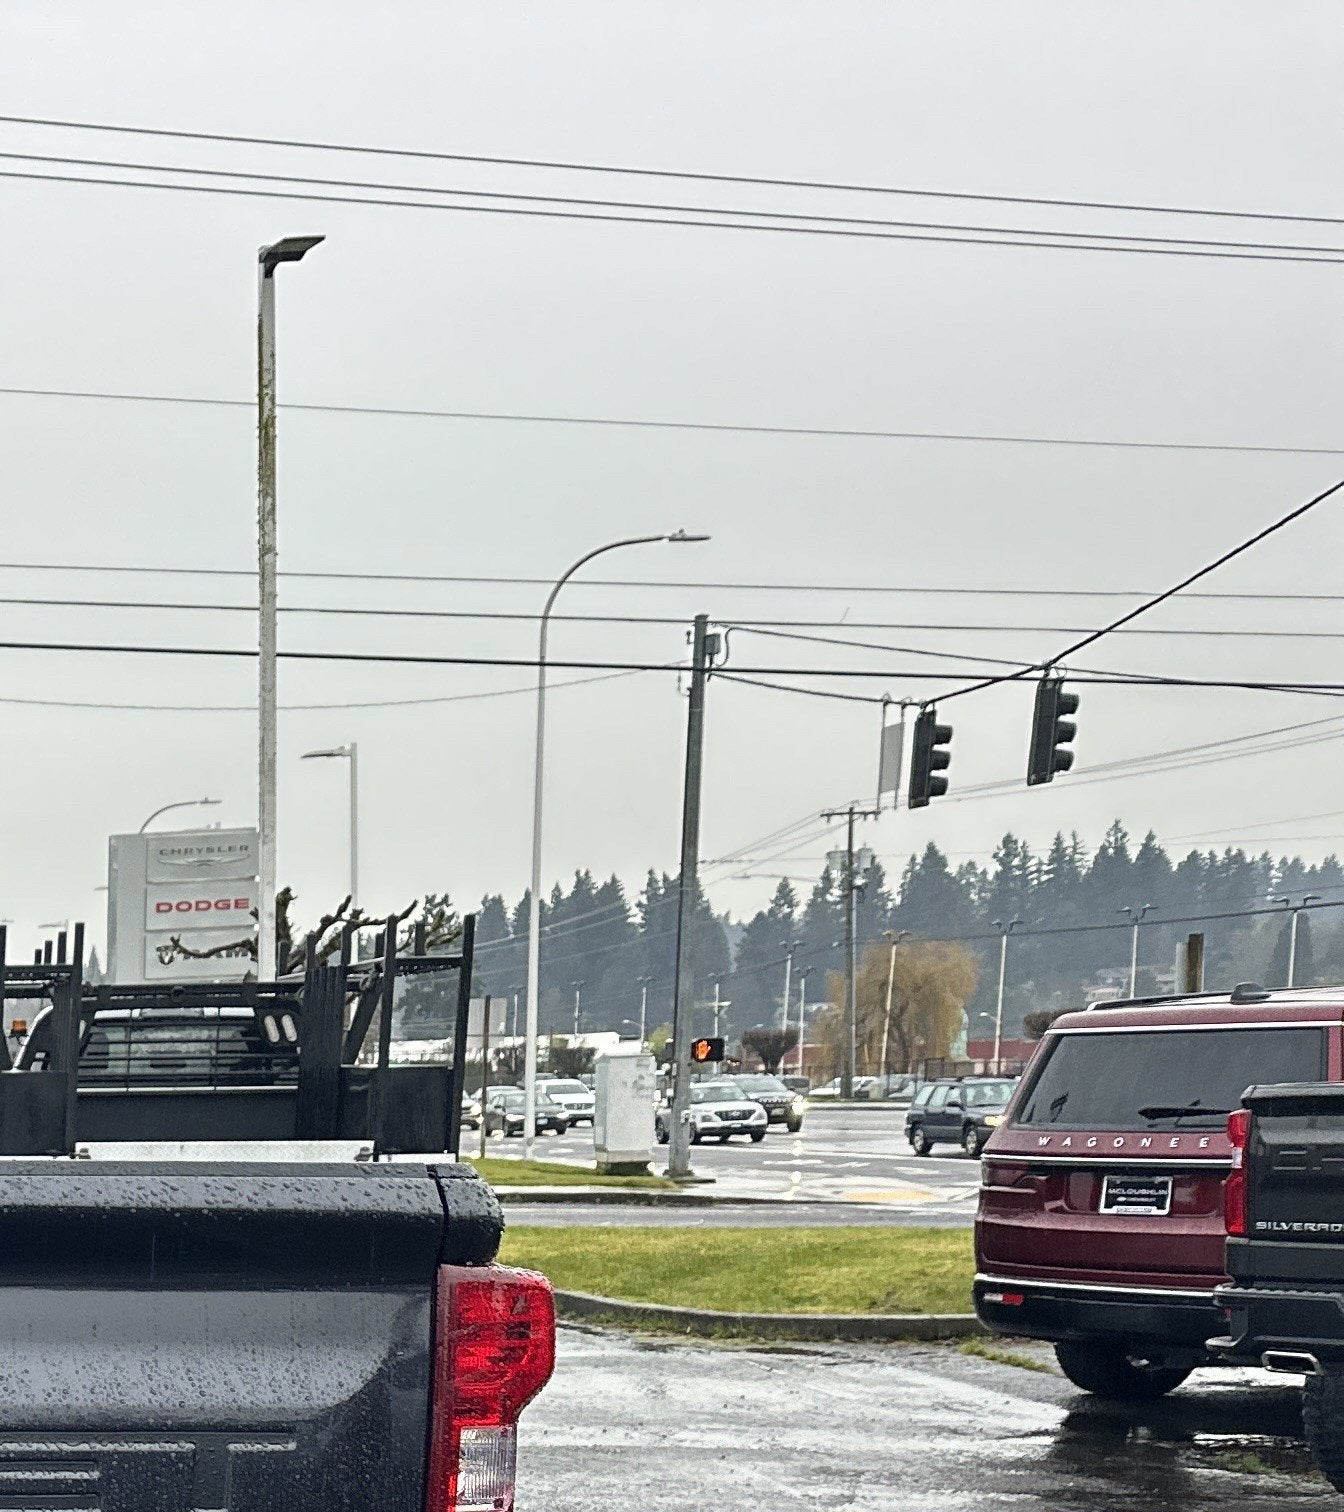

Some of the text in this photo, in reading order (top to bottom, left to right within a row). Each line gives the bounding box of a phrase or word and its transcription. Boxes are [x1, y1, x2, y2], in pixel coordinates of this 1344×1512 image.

[159, 844, 249, 856] CHRYSLER
[155, 898, 250, 914] DODGE
[1038, 1136, 1235, 1148] WAGONEE
[1255, 1221, 1344, 1233] SILVERAD
